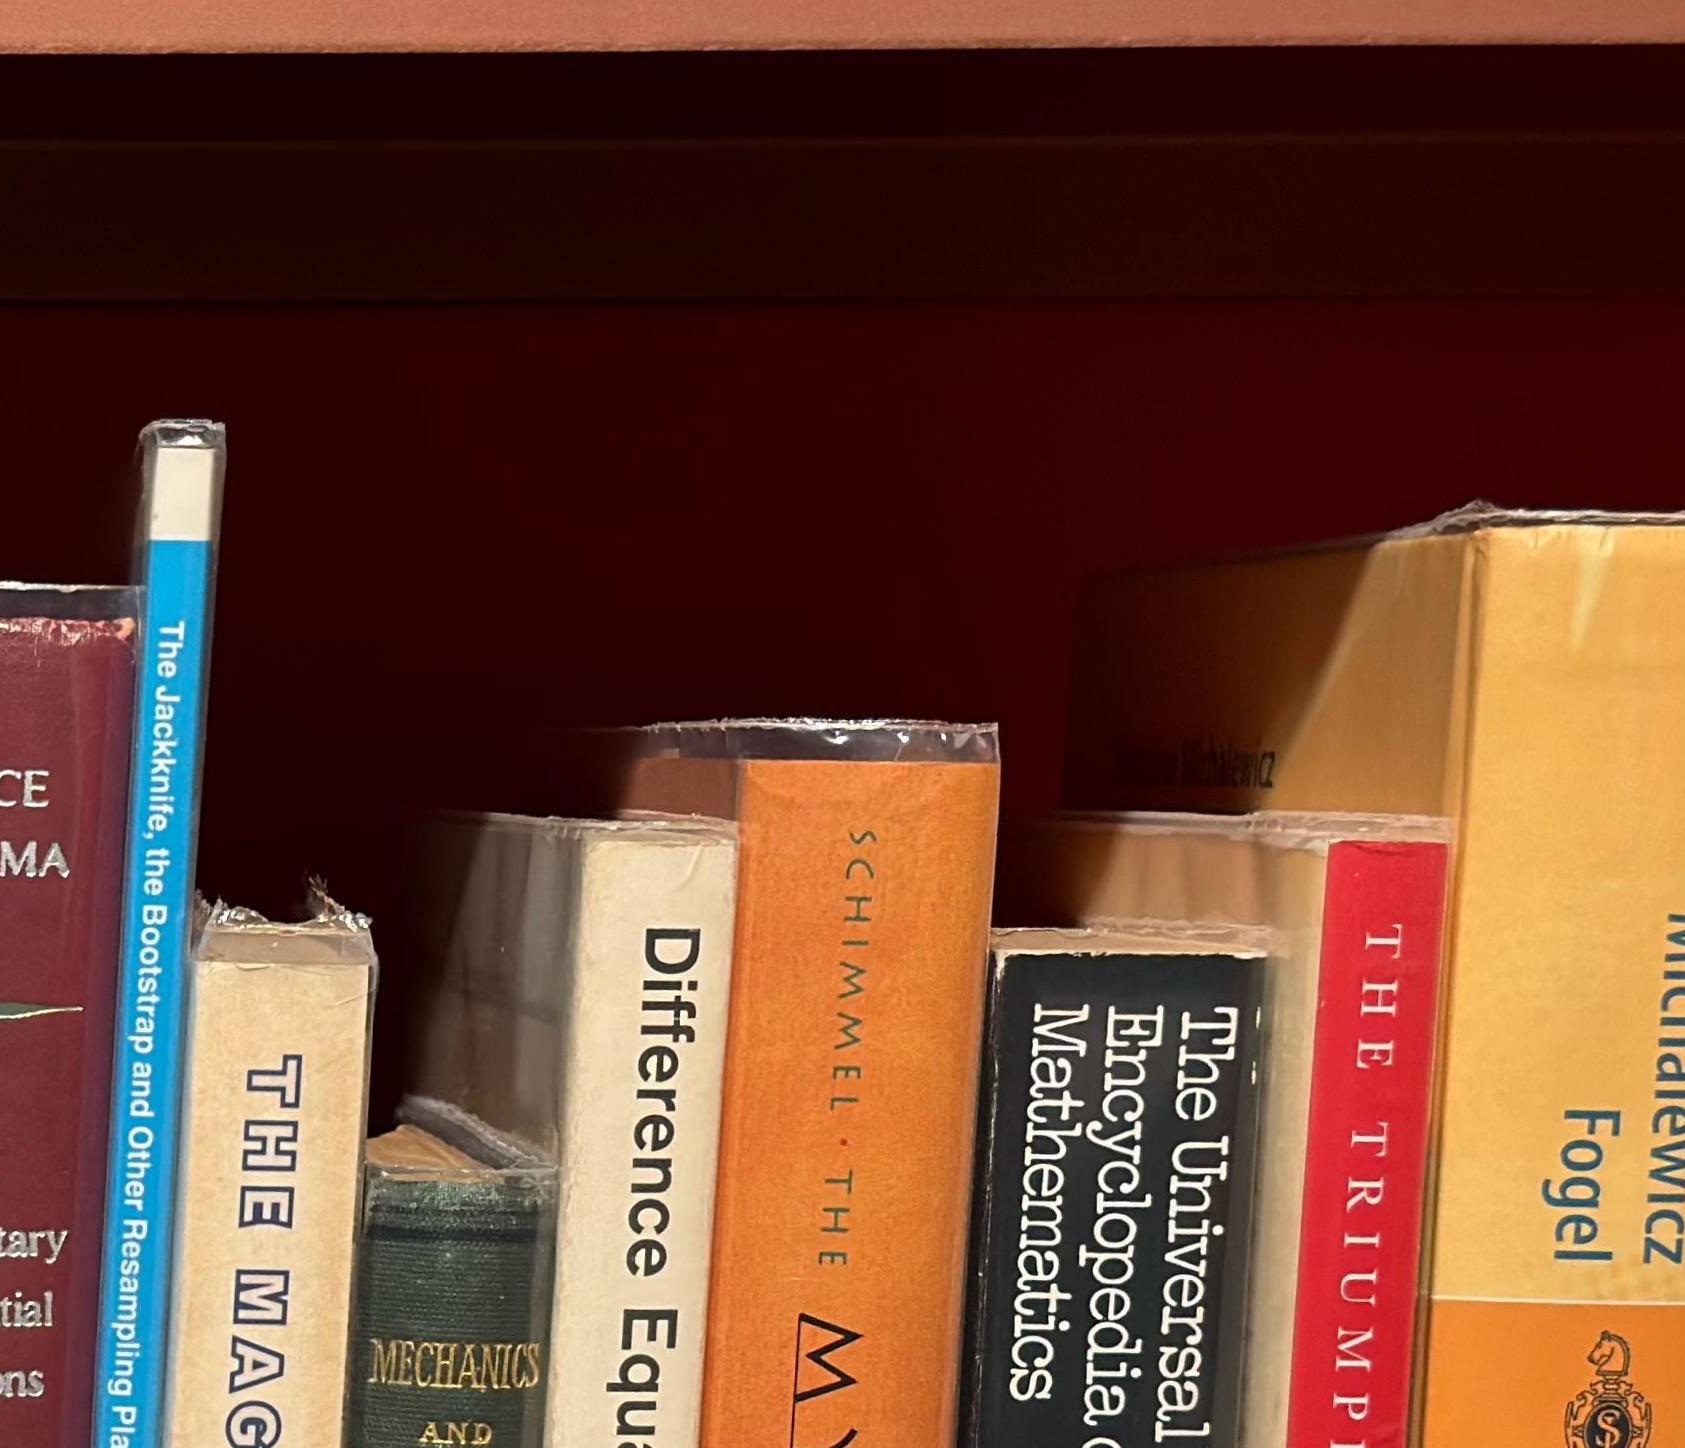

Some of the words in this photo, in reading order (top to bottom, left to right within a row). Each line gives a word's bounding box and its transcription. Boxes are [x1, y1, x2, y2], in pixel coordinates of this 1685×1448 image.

[157, 621, 184, 677] The
[143, 686, 180, 838] Jackknife,
[144, 848, 170, 895] the
[128, 905, 167, 1053] Bootstrap
[830, 831, 877, 1110] SCHIMMEL
[1357, 924, 1402, 1068] THE
[129, 1061, 154, 1117] and
[627, 929, 700, 1276] Difference
[1176, 1007, 1238, 1120] The
[124, 1127, 153, 1210] Other
[239, 1054, 302, 1228] THE
[1010, 1004, 1089, 1401] Mathematics
[1079, 1004, 1164, 1426] Encyclopedia
[1542, 1110, 1621, 1260] Fogel
[818, 1169, 853, 1265] THE
[1155, 1136, 1229, 1443] Universal
[108, 1220, 147, 1395] Resampling
[367, 1339, 539, 1393] MECHANICS
[419, 1422, 491, 1448] AND
